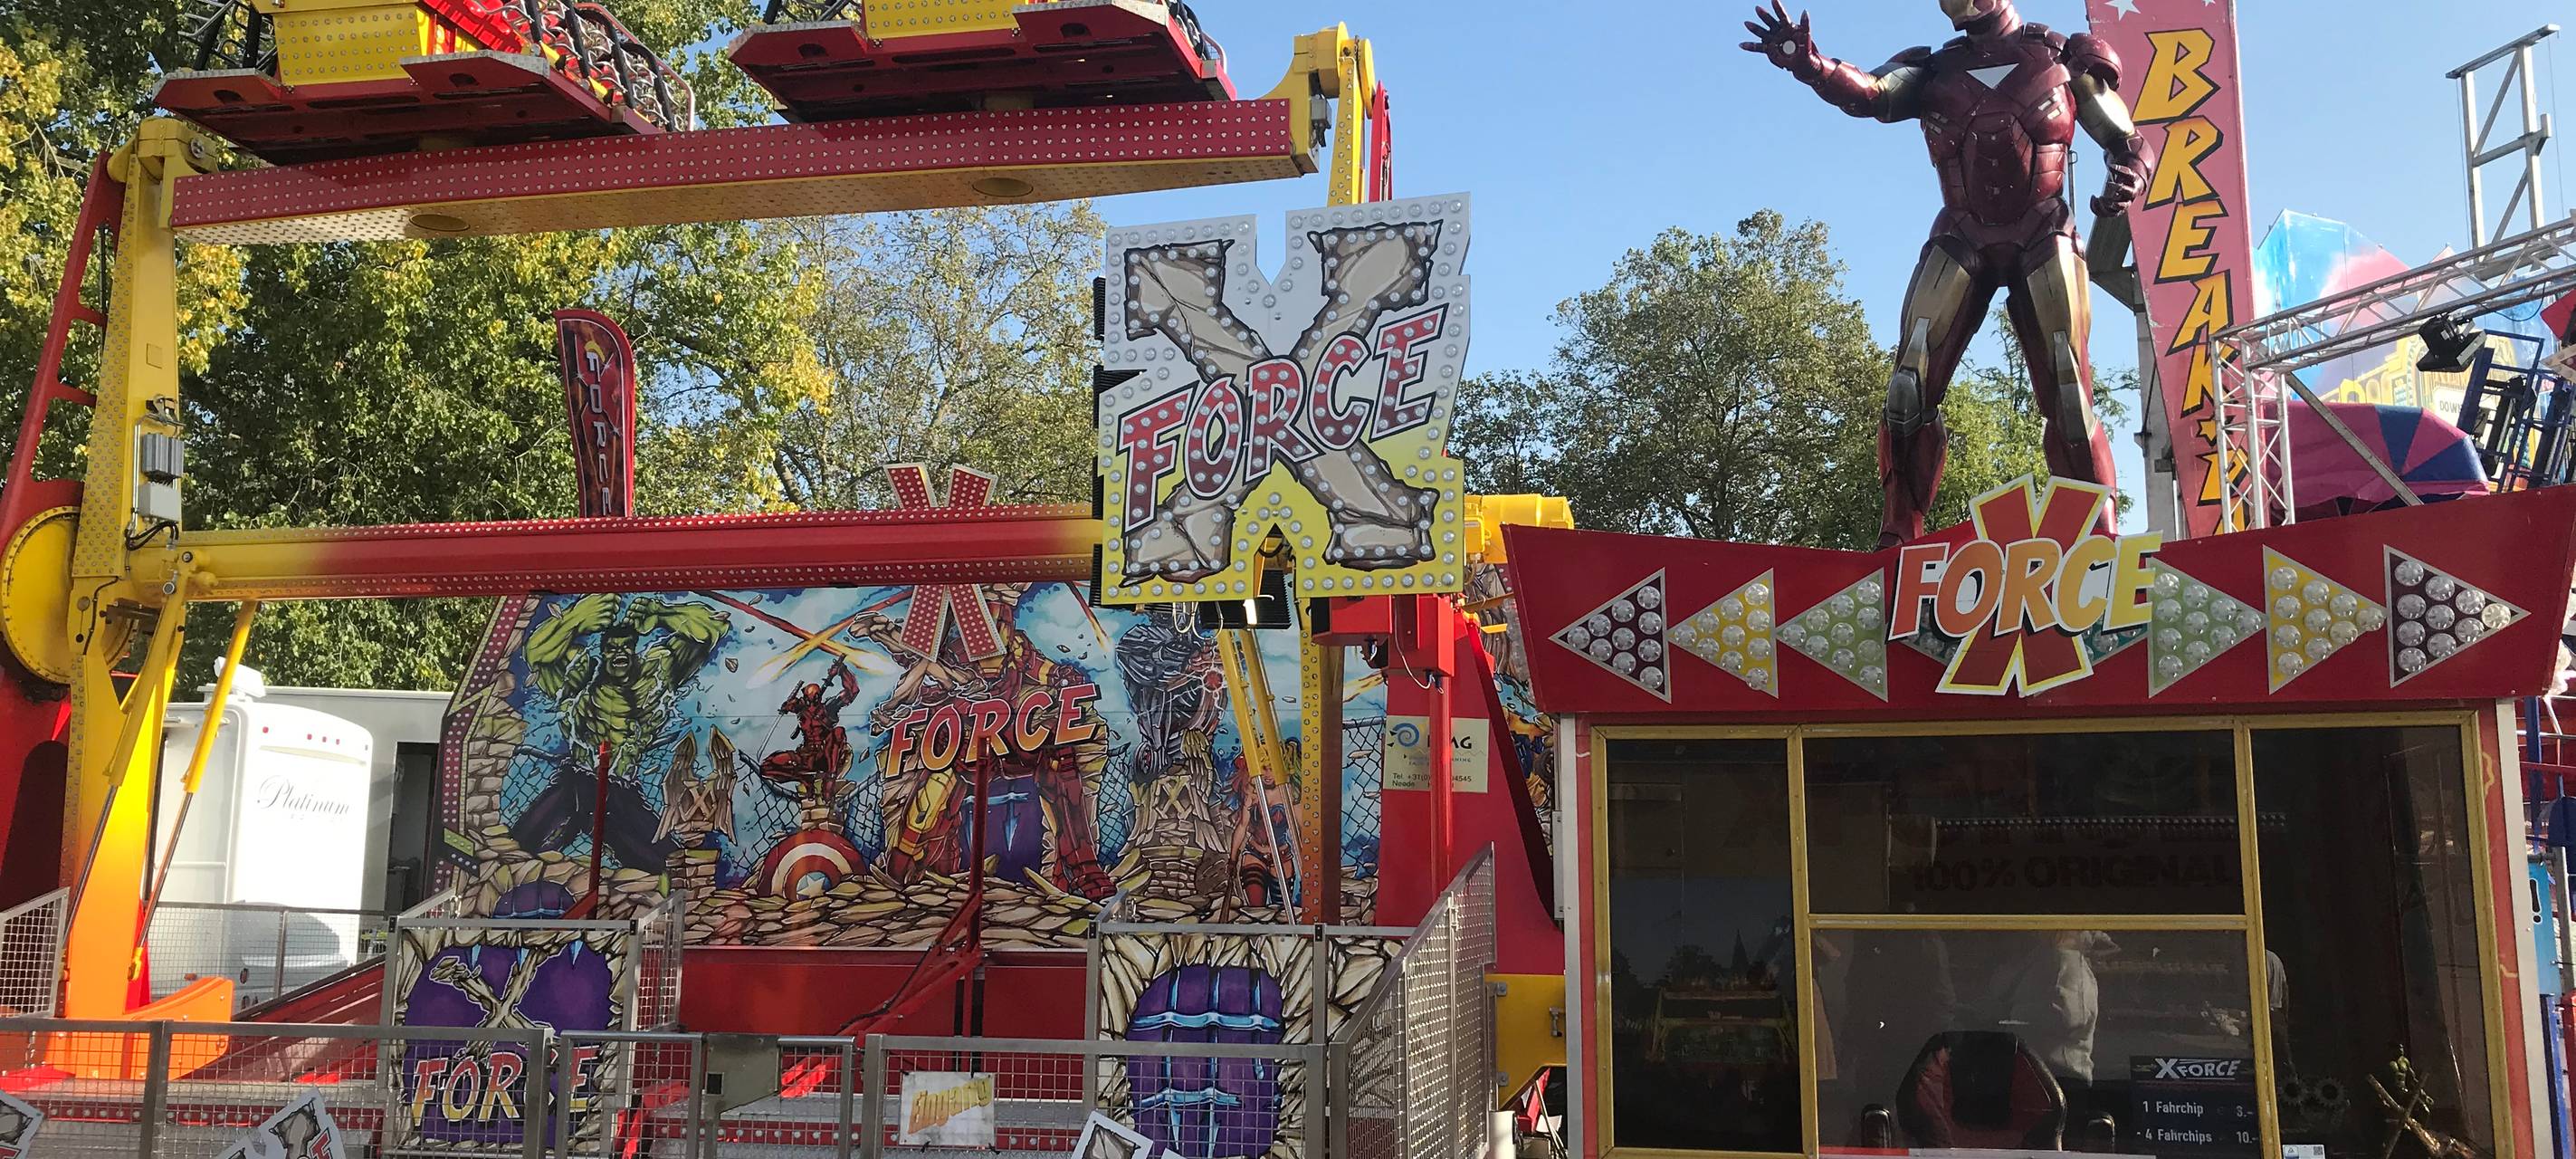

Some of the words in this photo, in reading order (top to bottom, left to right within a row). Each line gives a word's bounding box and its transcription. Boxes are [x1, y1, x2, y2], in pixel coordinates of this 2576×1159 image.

[1116, 302, 1450, 536] FORCE
[1119, 219, 1444, 588] X
[1888, 531, 2163, 640] FORCE
[1936, 473, 2112, 697] X
[884, 683, 1102, 780] FORCE
[256, 774, 349, 815] Platinum
[412, 1043, 603, 1127] FORE
[908, 1077, 993, 1135] Eingang
[2142, 1100, 2149, 1113] 1
[2156, 1100, 2204, 1116] Fahrchip
[2145, 1129, 2152, 1141] 4
[2158, 1128, 2213, 1145] Fahrchips
